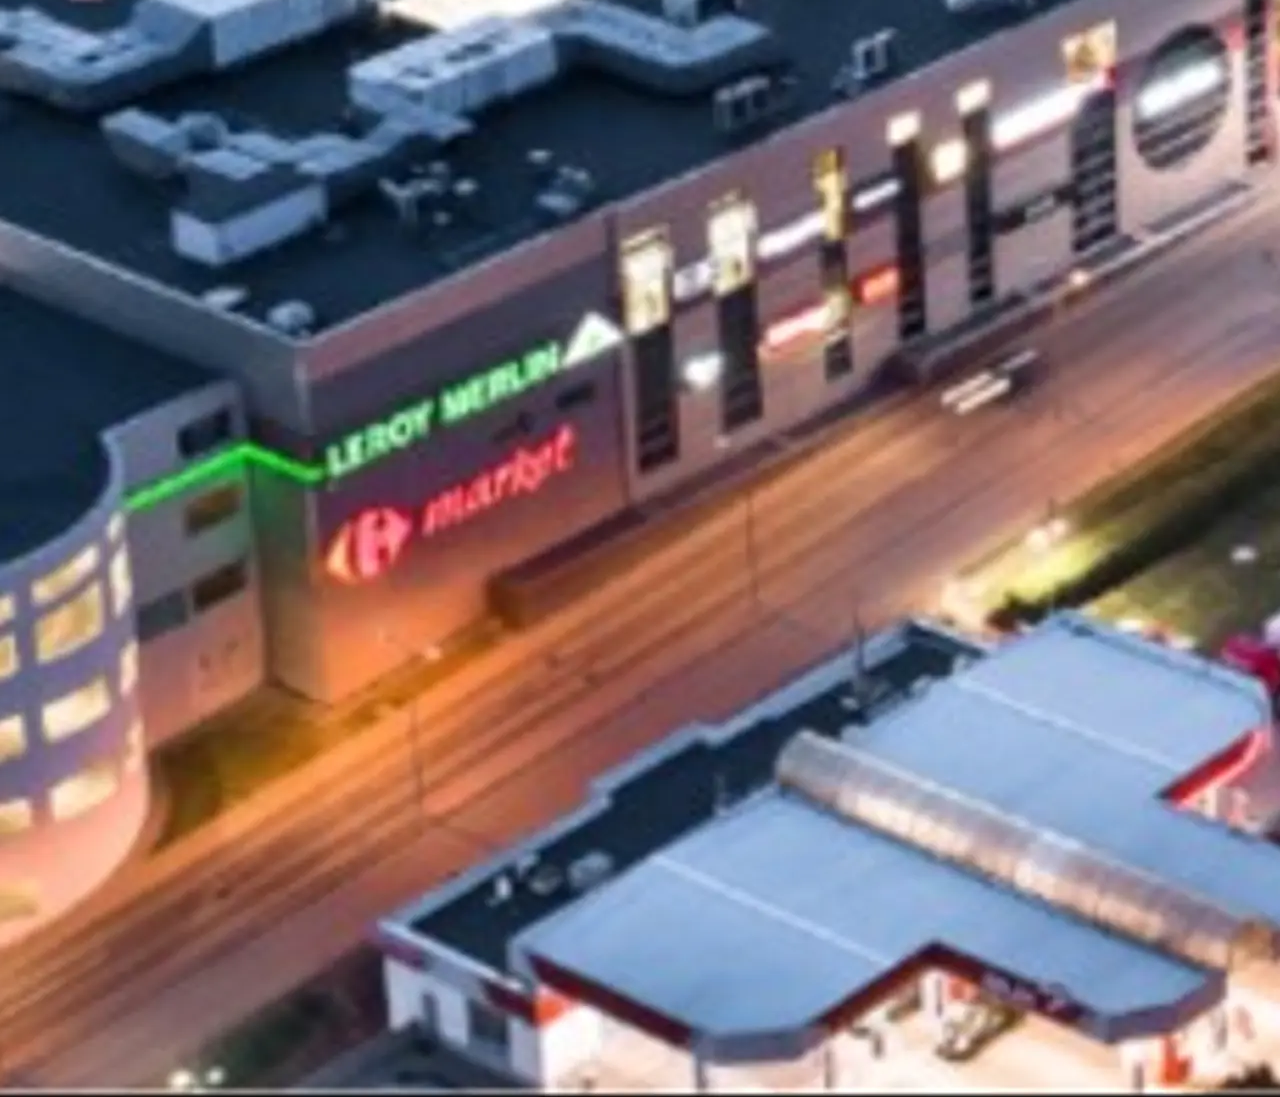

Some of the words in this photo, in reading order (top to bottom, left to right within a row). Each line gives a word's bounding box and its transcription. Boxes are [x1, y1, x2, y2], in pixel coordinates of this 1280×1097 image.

[325, 400, 434, 478] LEROY
[438, 340, 560, 424] MERLIN
[423, 424, 575, 538] market
